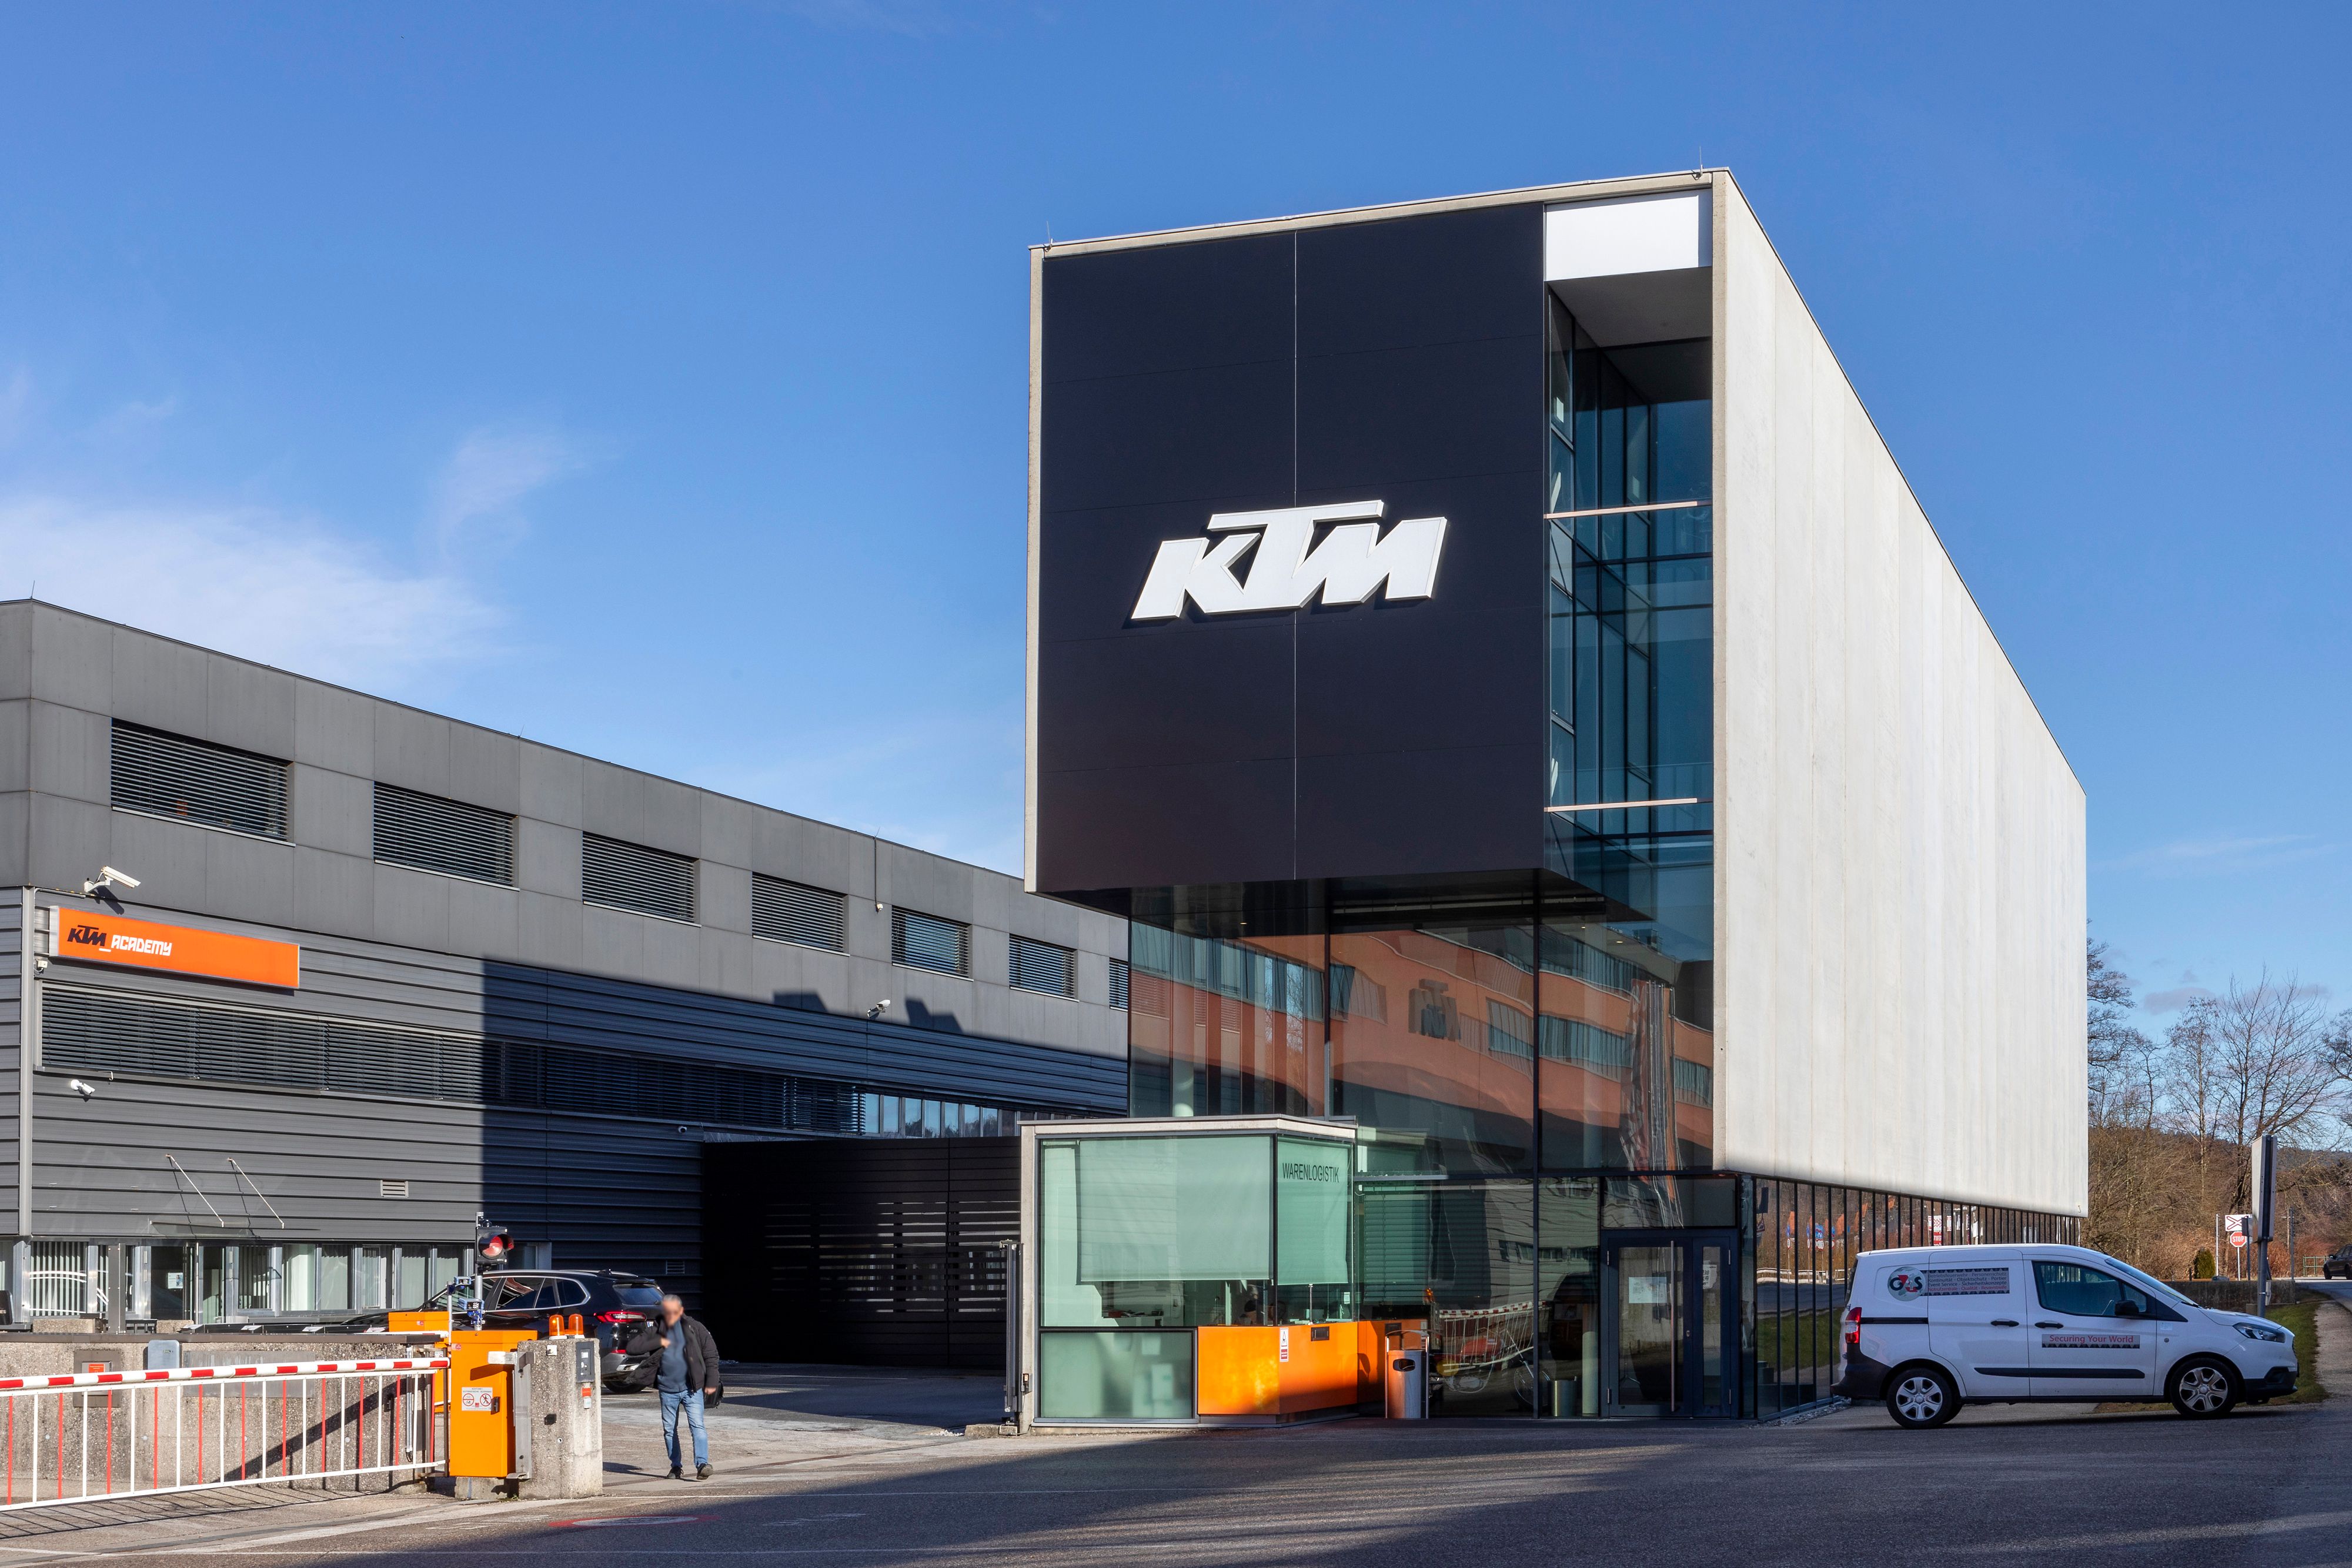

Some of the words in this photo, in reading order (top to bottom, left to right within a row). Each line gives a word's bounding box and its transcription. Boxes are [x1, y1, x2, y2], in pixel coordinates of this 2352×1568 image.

[1131, 500, 1447, 620] KTM
[67, 925, 106, 947] KTM
[1282, 1162, 1339, 1183] WARENLOGISTIK
[1889, 1275, 1923, 1293] G4S
[2050, 1335, 2085, 1343] Securing
